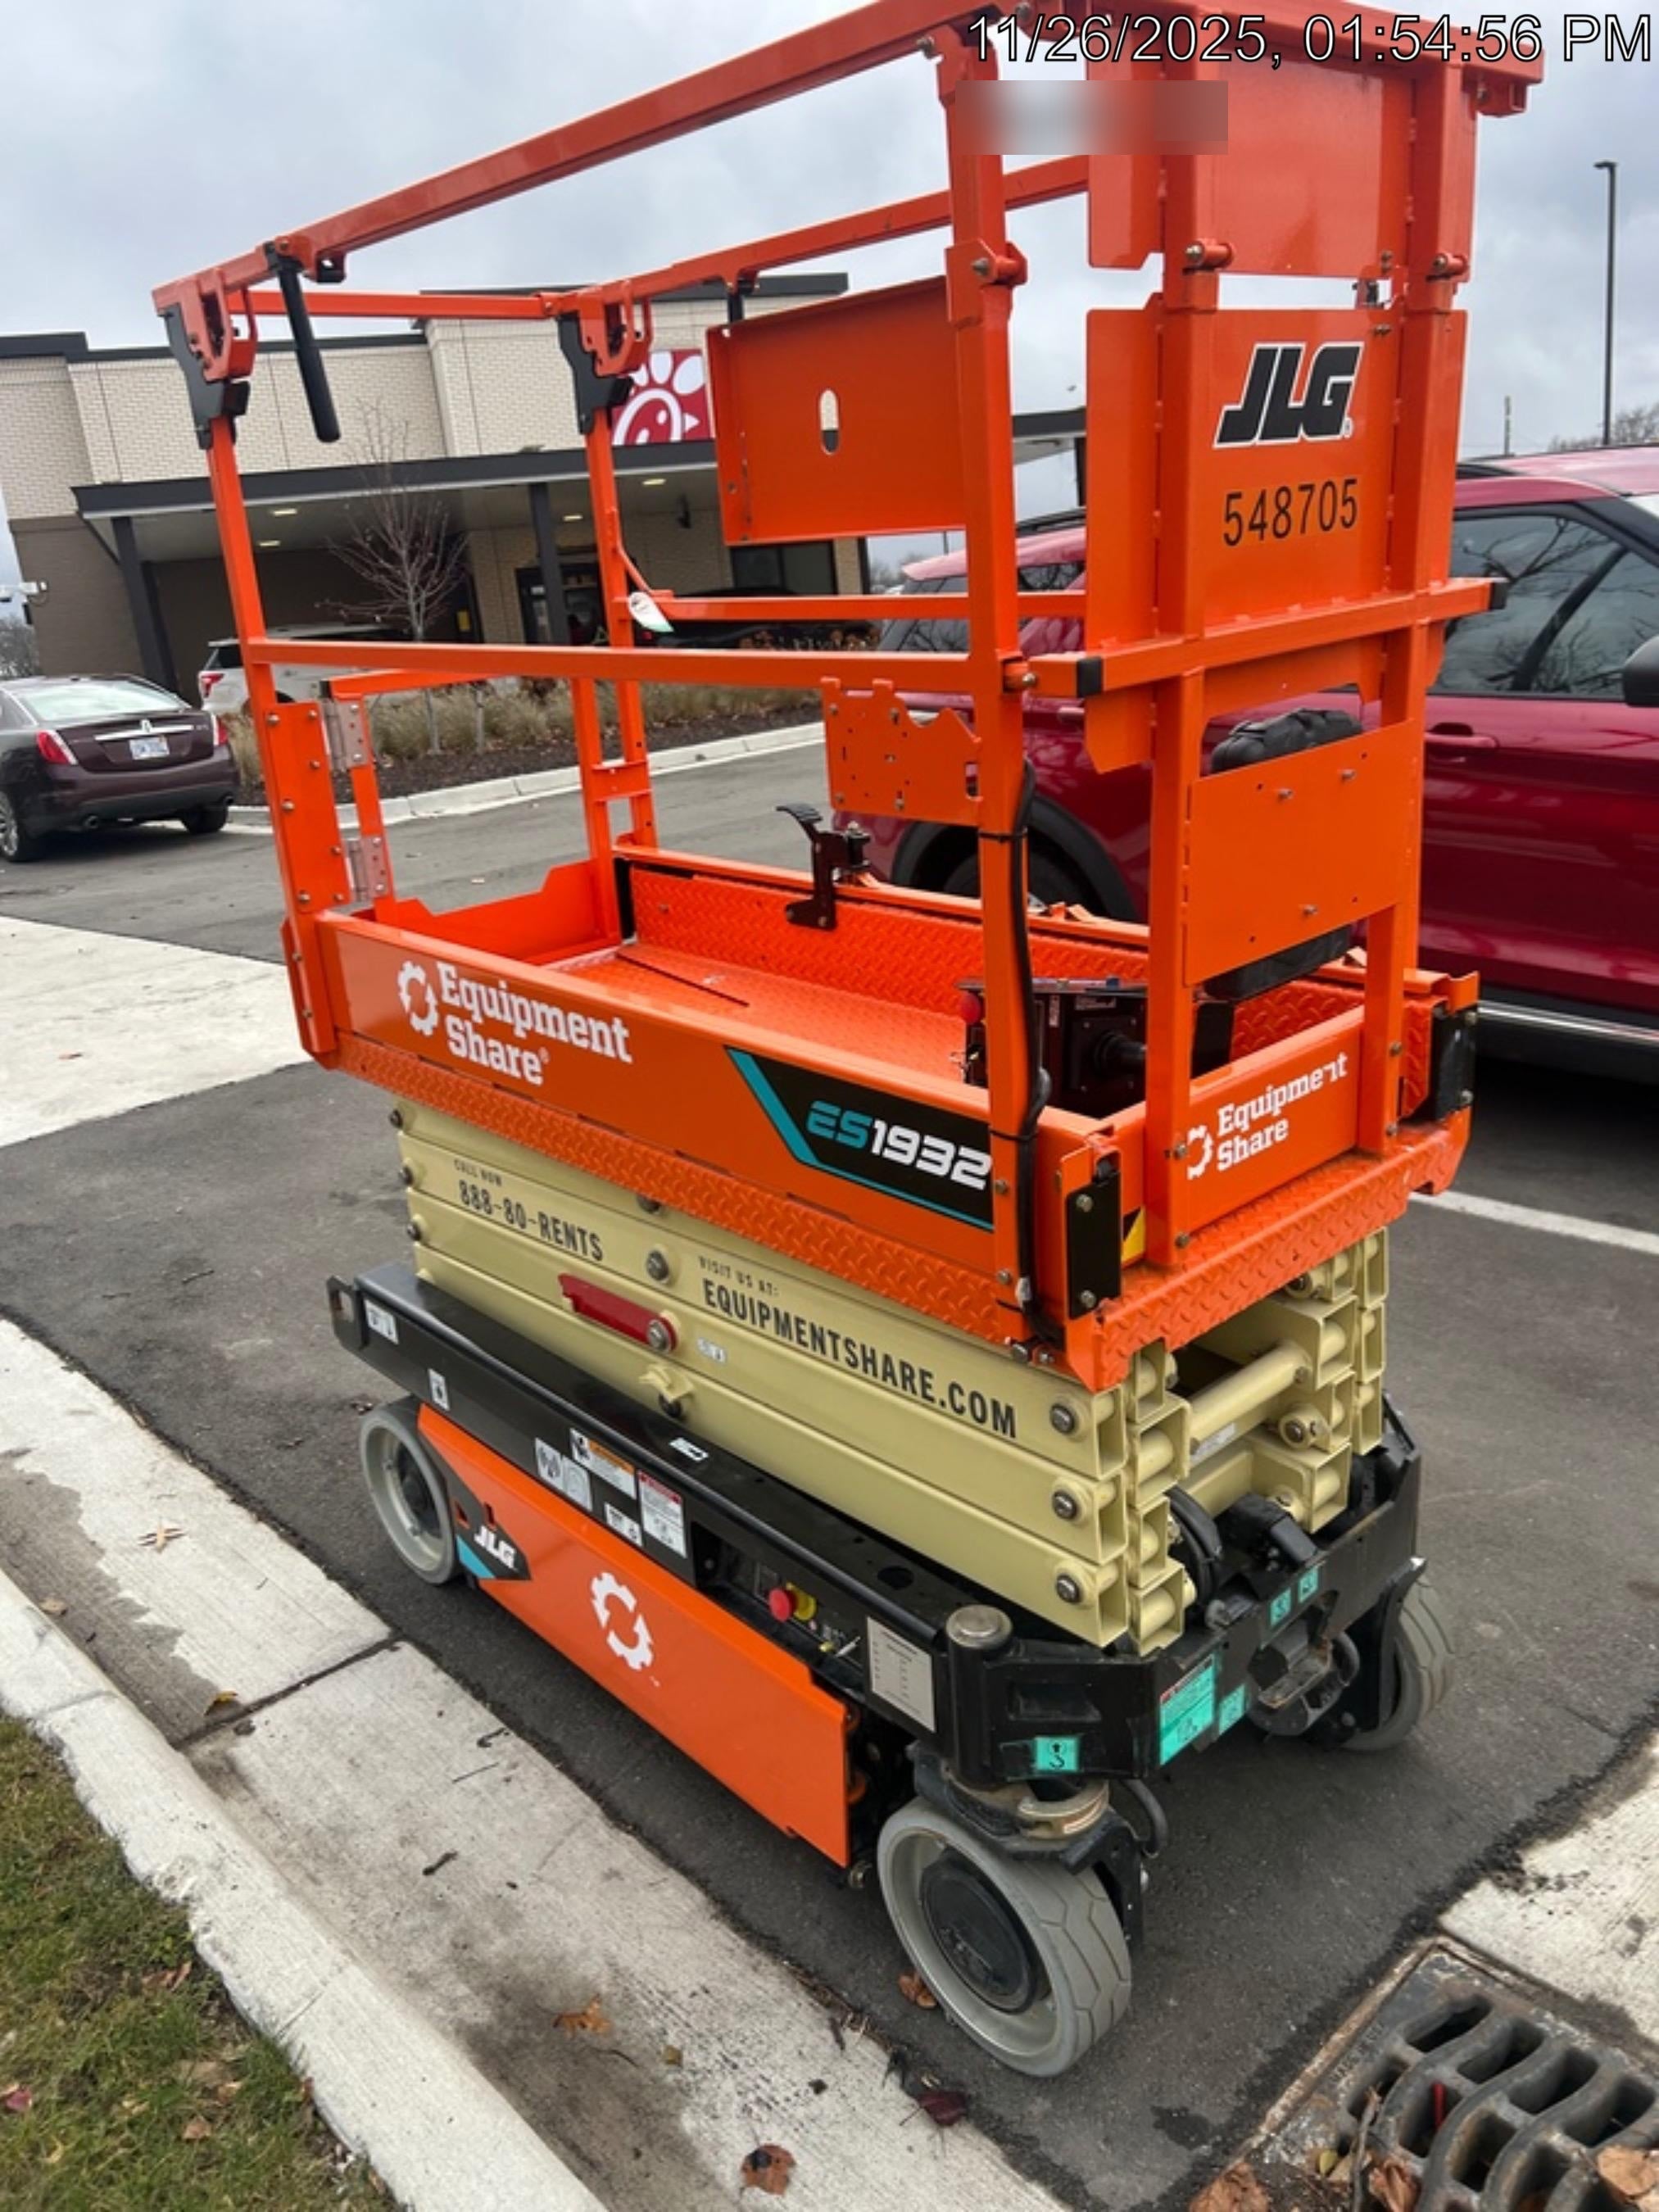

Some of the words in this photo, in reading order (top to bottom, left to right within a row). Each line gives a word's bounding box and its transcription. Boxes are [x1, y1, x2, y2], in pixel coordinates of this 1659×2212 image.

[1213, 341, 1365, 449] JLG
[1223, 478, 1358, 546] 548705
[437, 960, 632, 1063] Equipment
[806, 1100, 993, 1191] ES1932
[1217, 1118, 1289, 1172] Share
[459, 1179, 603, 1262] 888-80-RENTS
[698, 1255, 732, 1279] VISIT
[736, 1270, 753, 1289] US
[702, 1276, 1017, 1439] EQUIPMENTSHARE.COM
[474, 1524, 515, 1569] JLG
